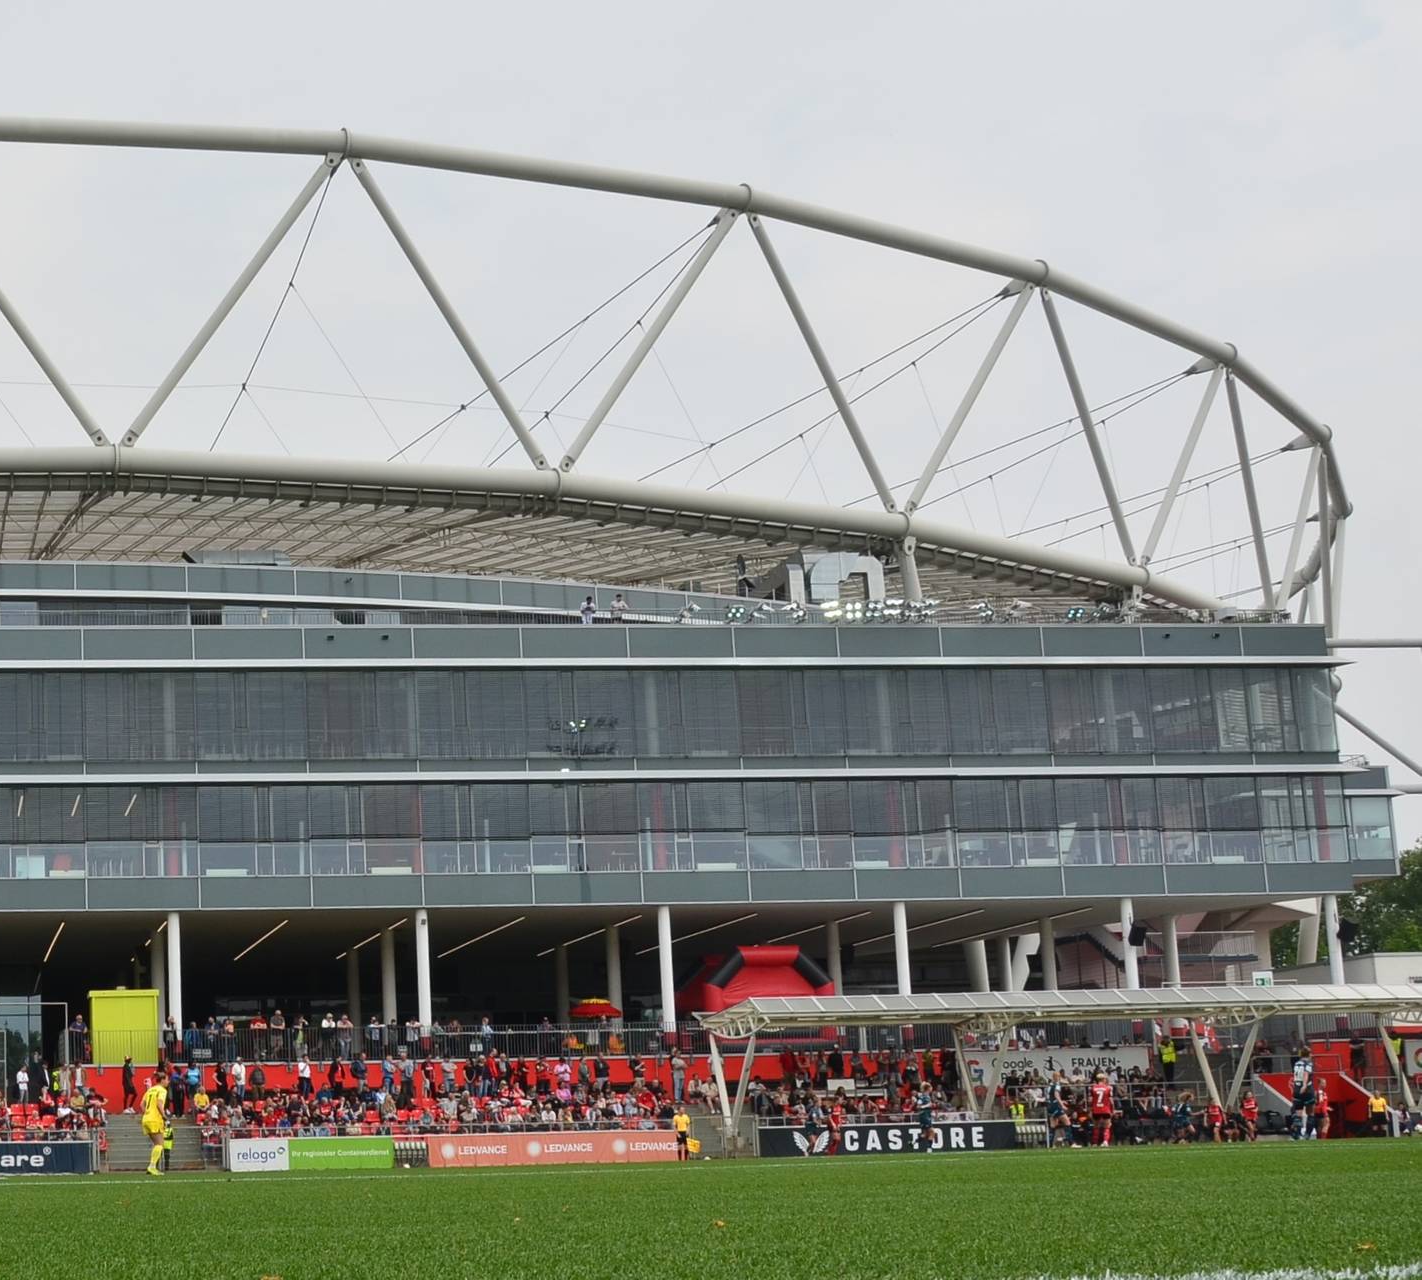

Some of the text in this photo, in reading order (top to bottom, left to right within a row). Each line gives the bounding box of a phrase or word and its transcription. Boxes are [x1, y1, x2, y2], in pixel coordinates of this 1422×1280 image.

[1096, 1090, 1104, 1103] 7
[458, 1145, 507, 1156] LEDVANCE
[544, 1143, 593, 1153] LEDVANCE
[629, 1141, 678, 1152] LEDVANCE
[237, 1147, 276, 1163] reloga
